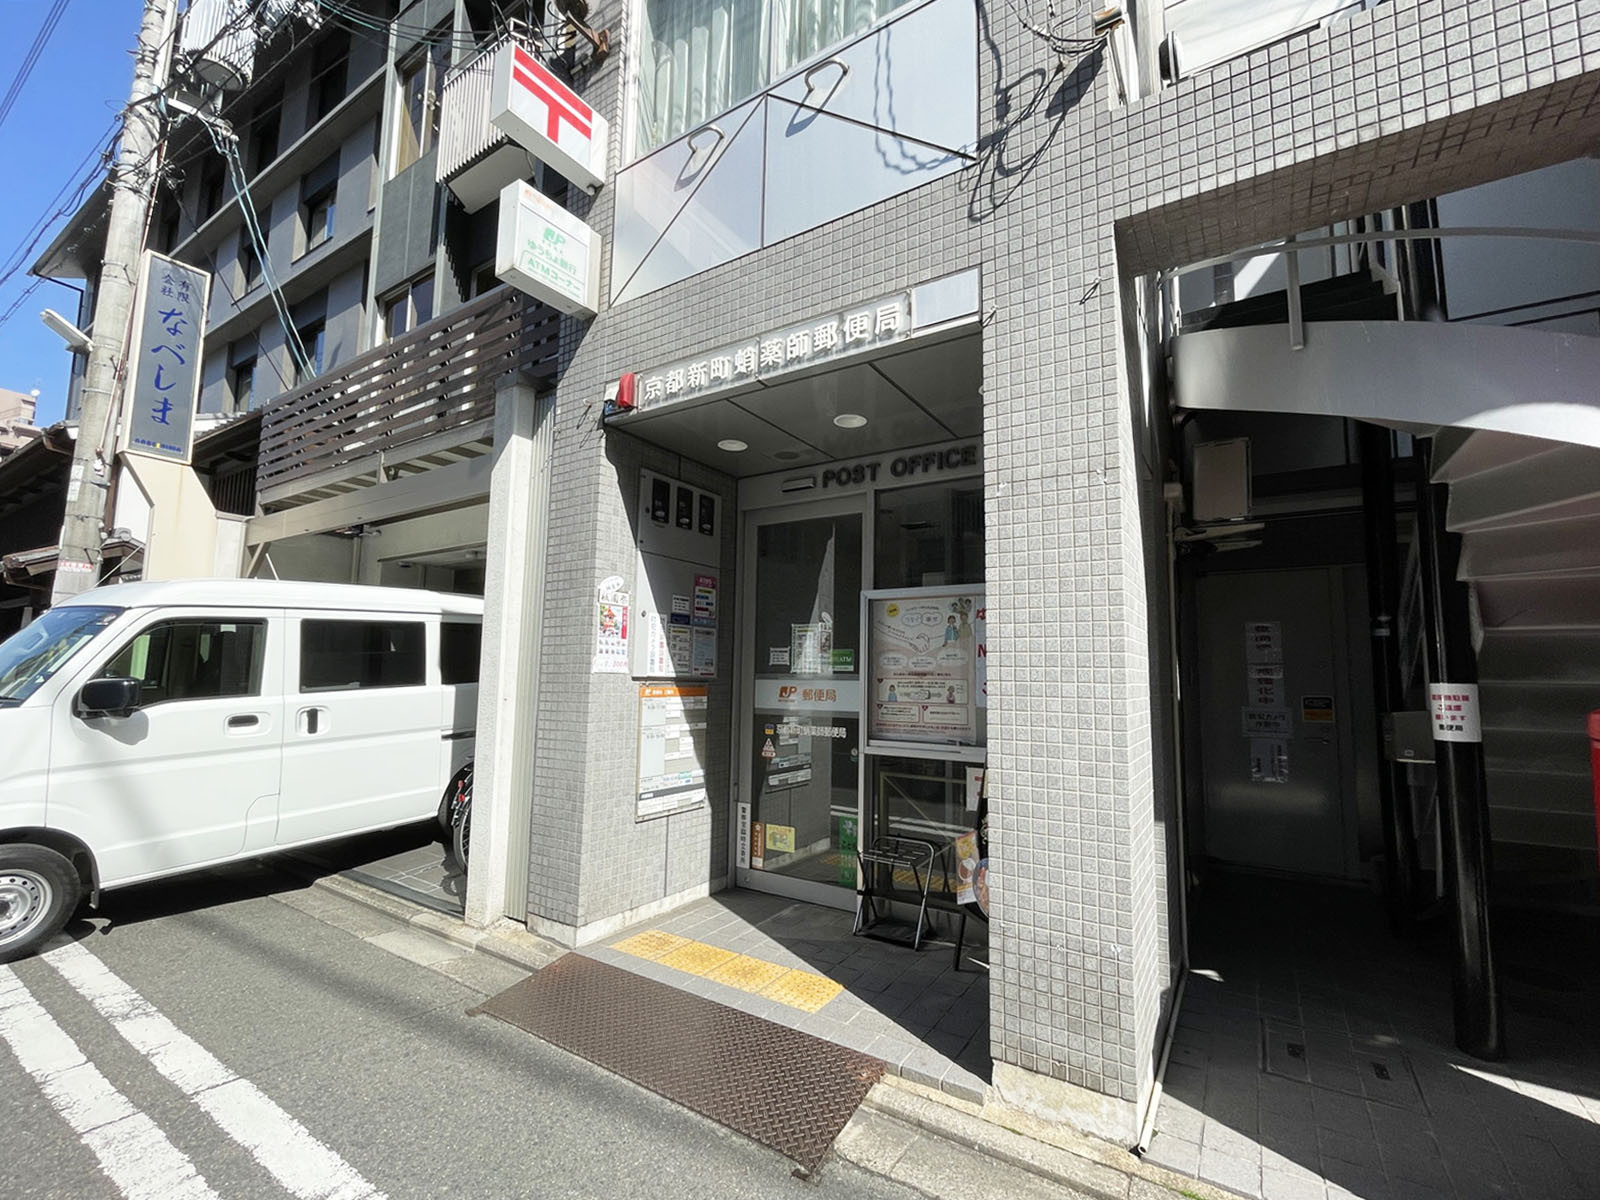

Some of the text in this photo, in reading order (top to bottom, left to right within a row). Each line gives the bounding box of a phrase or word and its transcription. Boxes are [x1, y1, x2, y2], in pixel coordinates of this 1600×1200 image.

[160, 273, 176, 298] 会社
[177, 278, 193, 304] 有限
[150, 307, 188, 426] なべしま
[643, 302, 902, 401] 京都新町蛸薬師郵便局
[822, 445, 978, 489] POST OFFICE
[802, 688, 837, 702] 郵便局
